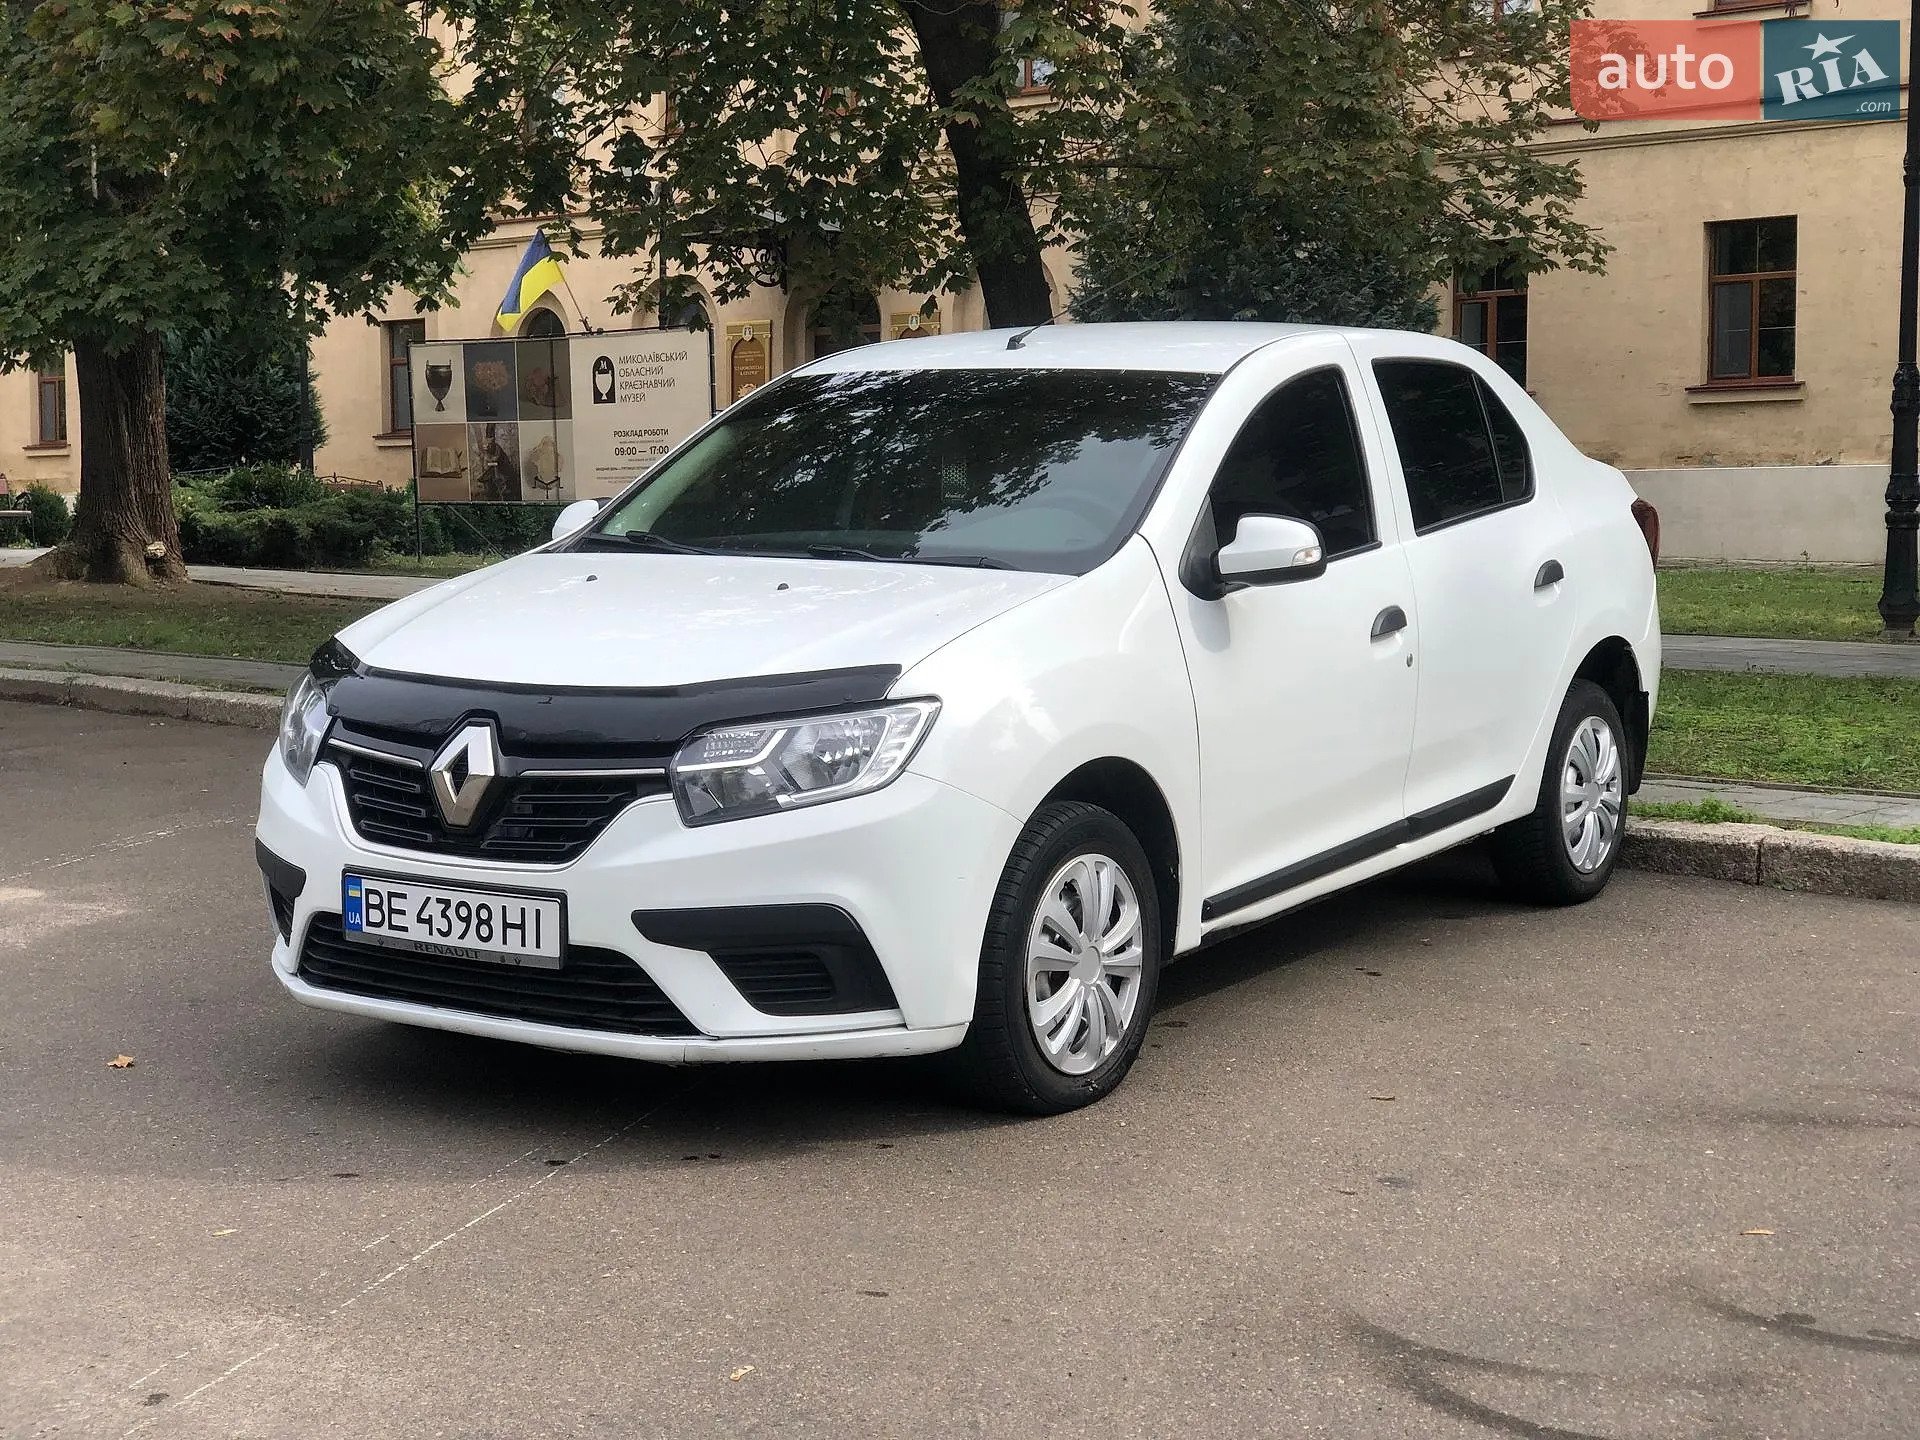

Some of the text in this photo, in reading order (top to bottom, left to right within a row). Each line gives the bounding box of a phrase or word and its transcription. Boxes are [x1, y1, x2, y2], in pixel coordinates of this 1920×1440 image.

[619, 351, 688, 364] МИКОЛАЇВСЬКИЙ
[619, 365, 664, 377] ОБЛАСНИЙ
[619, 377, 676, 390] КРАЄЗНАВЧИЙ
[620, 392, 646, 403] МУЗЕЙ
[613, 428, 669, 438] РОЗКЛАД РОБОТИ
[614, 446, 637, 456] 09:00
[649, 445, 669, 455] 17:00
[348, 911, 362, 926] UA
[416, 896, 494, 943] 4398
[413, 942, 481, 960] RENAULT
